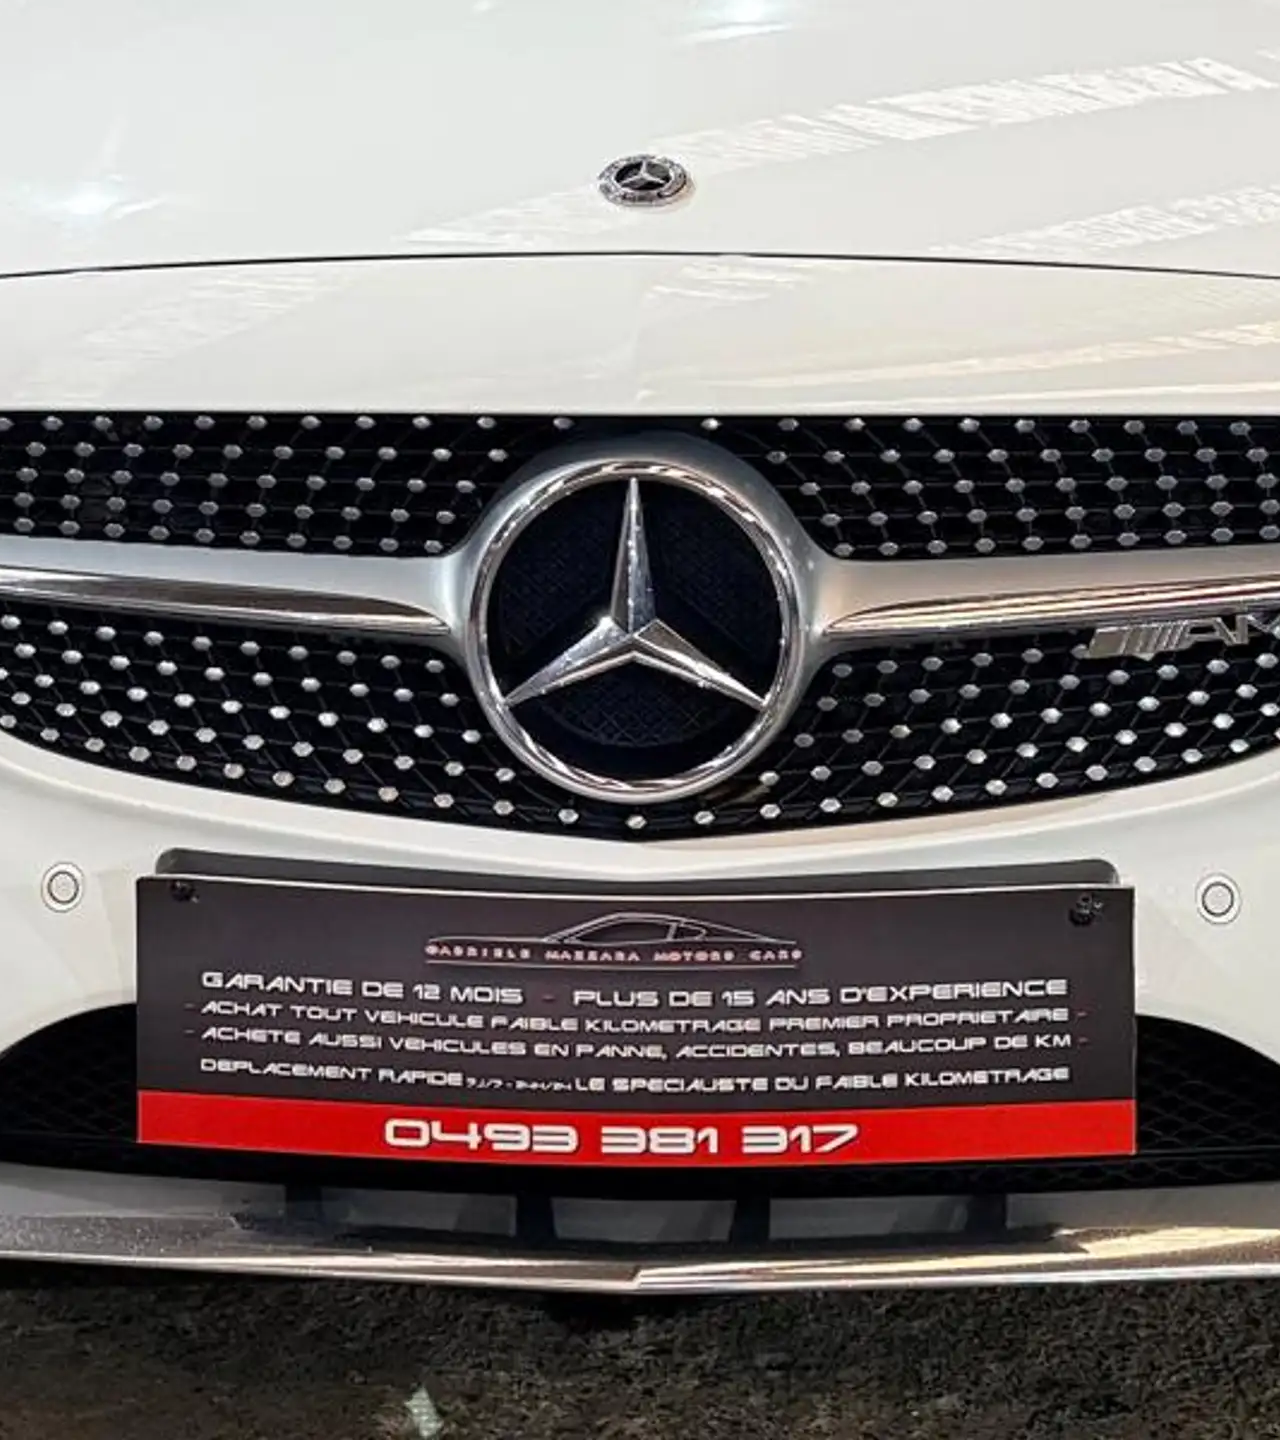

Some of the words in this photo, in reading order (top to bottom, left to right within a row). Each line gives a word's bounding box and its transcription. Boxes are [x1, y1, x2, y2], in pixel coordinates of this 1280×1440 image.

[201, 971, 353, 997] GARANTIE
[361, 981, 404, 998] DE
[413, 983, 440, 1000] 12
[451, 986, 523, 1004] MOIS
[574, 990, 659, 1008] PLUS
[669, 991, 713, 1007] DE
[722, 989, 755, 1007] 15
[766, 988, 830, 1006] ANS
[840, 978, 1068, 1003] D'EXPERIENCE
[200, 1000, 282, 1018] ACHAT
[291, 1004, 357, 1022] TOUT
[364, 1009, 484, 1029] VEHICULE
[491, 1015, 579, 1032] FAIBLE
[585, 1017, 761, 1033] KILOMETRAGE
[769, 1014, 880, 1031] PREMIER
[887, 1008, 1069, 1027] PROPRIETAIRE
[201, 1026, 300, 1045] ACHETE
[308, 1031, 382, 1049] AUSSI
[390, 1035, 527, 1056] VEHICULES
[534, 1043, 569, 1057] EN
[576, 1044, 668, 1060] PANNE,
[676, 1041, 841, 1059] ACCIDENTES,
[848, 1036, 987, 1056] BEAUCOUP
[994, 1035, 1028, 1049] DE
[1035, 1033, 1072, 1048] KM
[200, 1058, 372, 1080] DEPLACEMENT
[378, 1068, 463, 1087] RAPIDE
[575, 1076, 606, 1092] LE
[774, 1075, 809, 1092] DU
[815, 1072, 899, 1091] FAIBLE
[904, 1066, 1071, 1087] KILOMETRAGE
[383, 1117, 580, 1154] 0493
[601, 1123, 719, 1155] 381
[741, 1122, 858, 1155] 317
